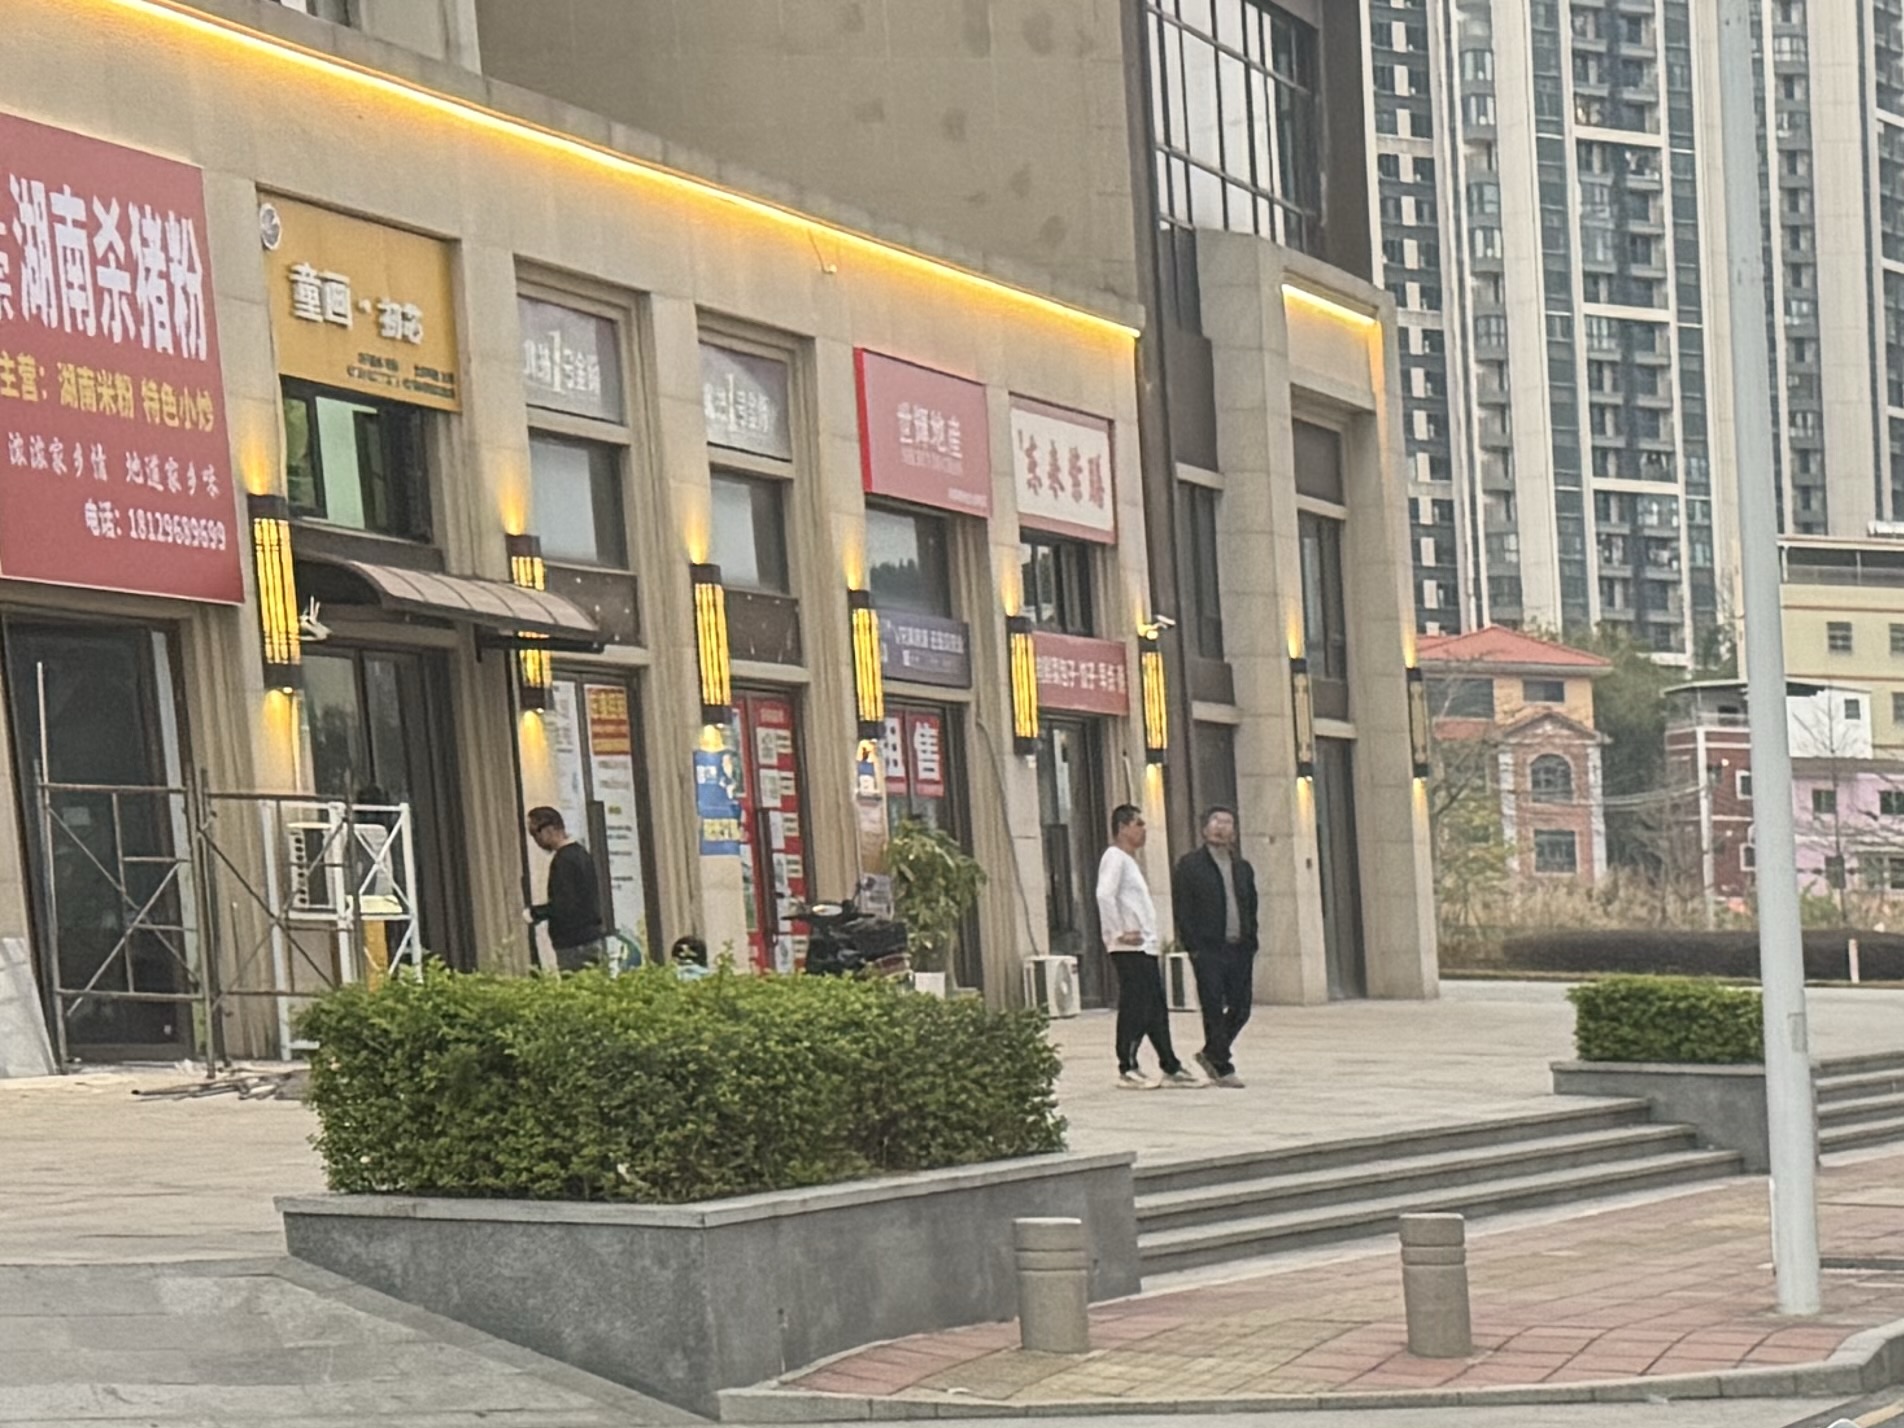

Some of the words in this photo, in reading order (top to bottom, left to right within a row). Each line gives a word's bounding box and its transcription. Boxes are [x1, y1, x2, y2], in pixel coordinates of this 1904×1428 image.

[0, 173, 206, 361] 湖南杀猪粉
[141, 376, 214, 432] 特色小炒
[8, 431, 108, 481] 浓浓家乡情
[125, 450, 220, 498] 地道家乡味
